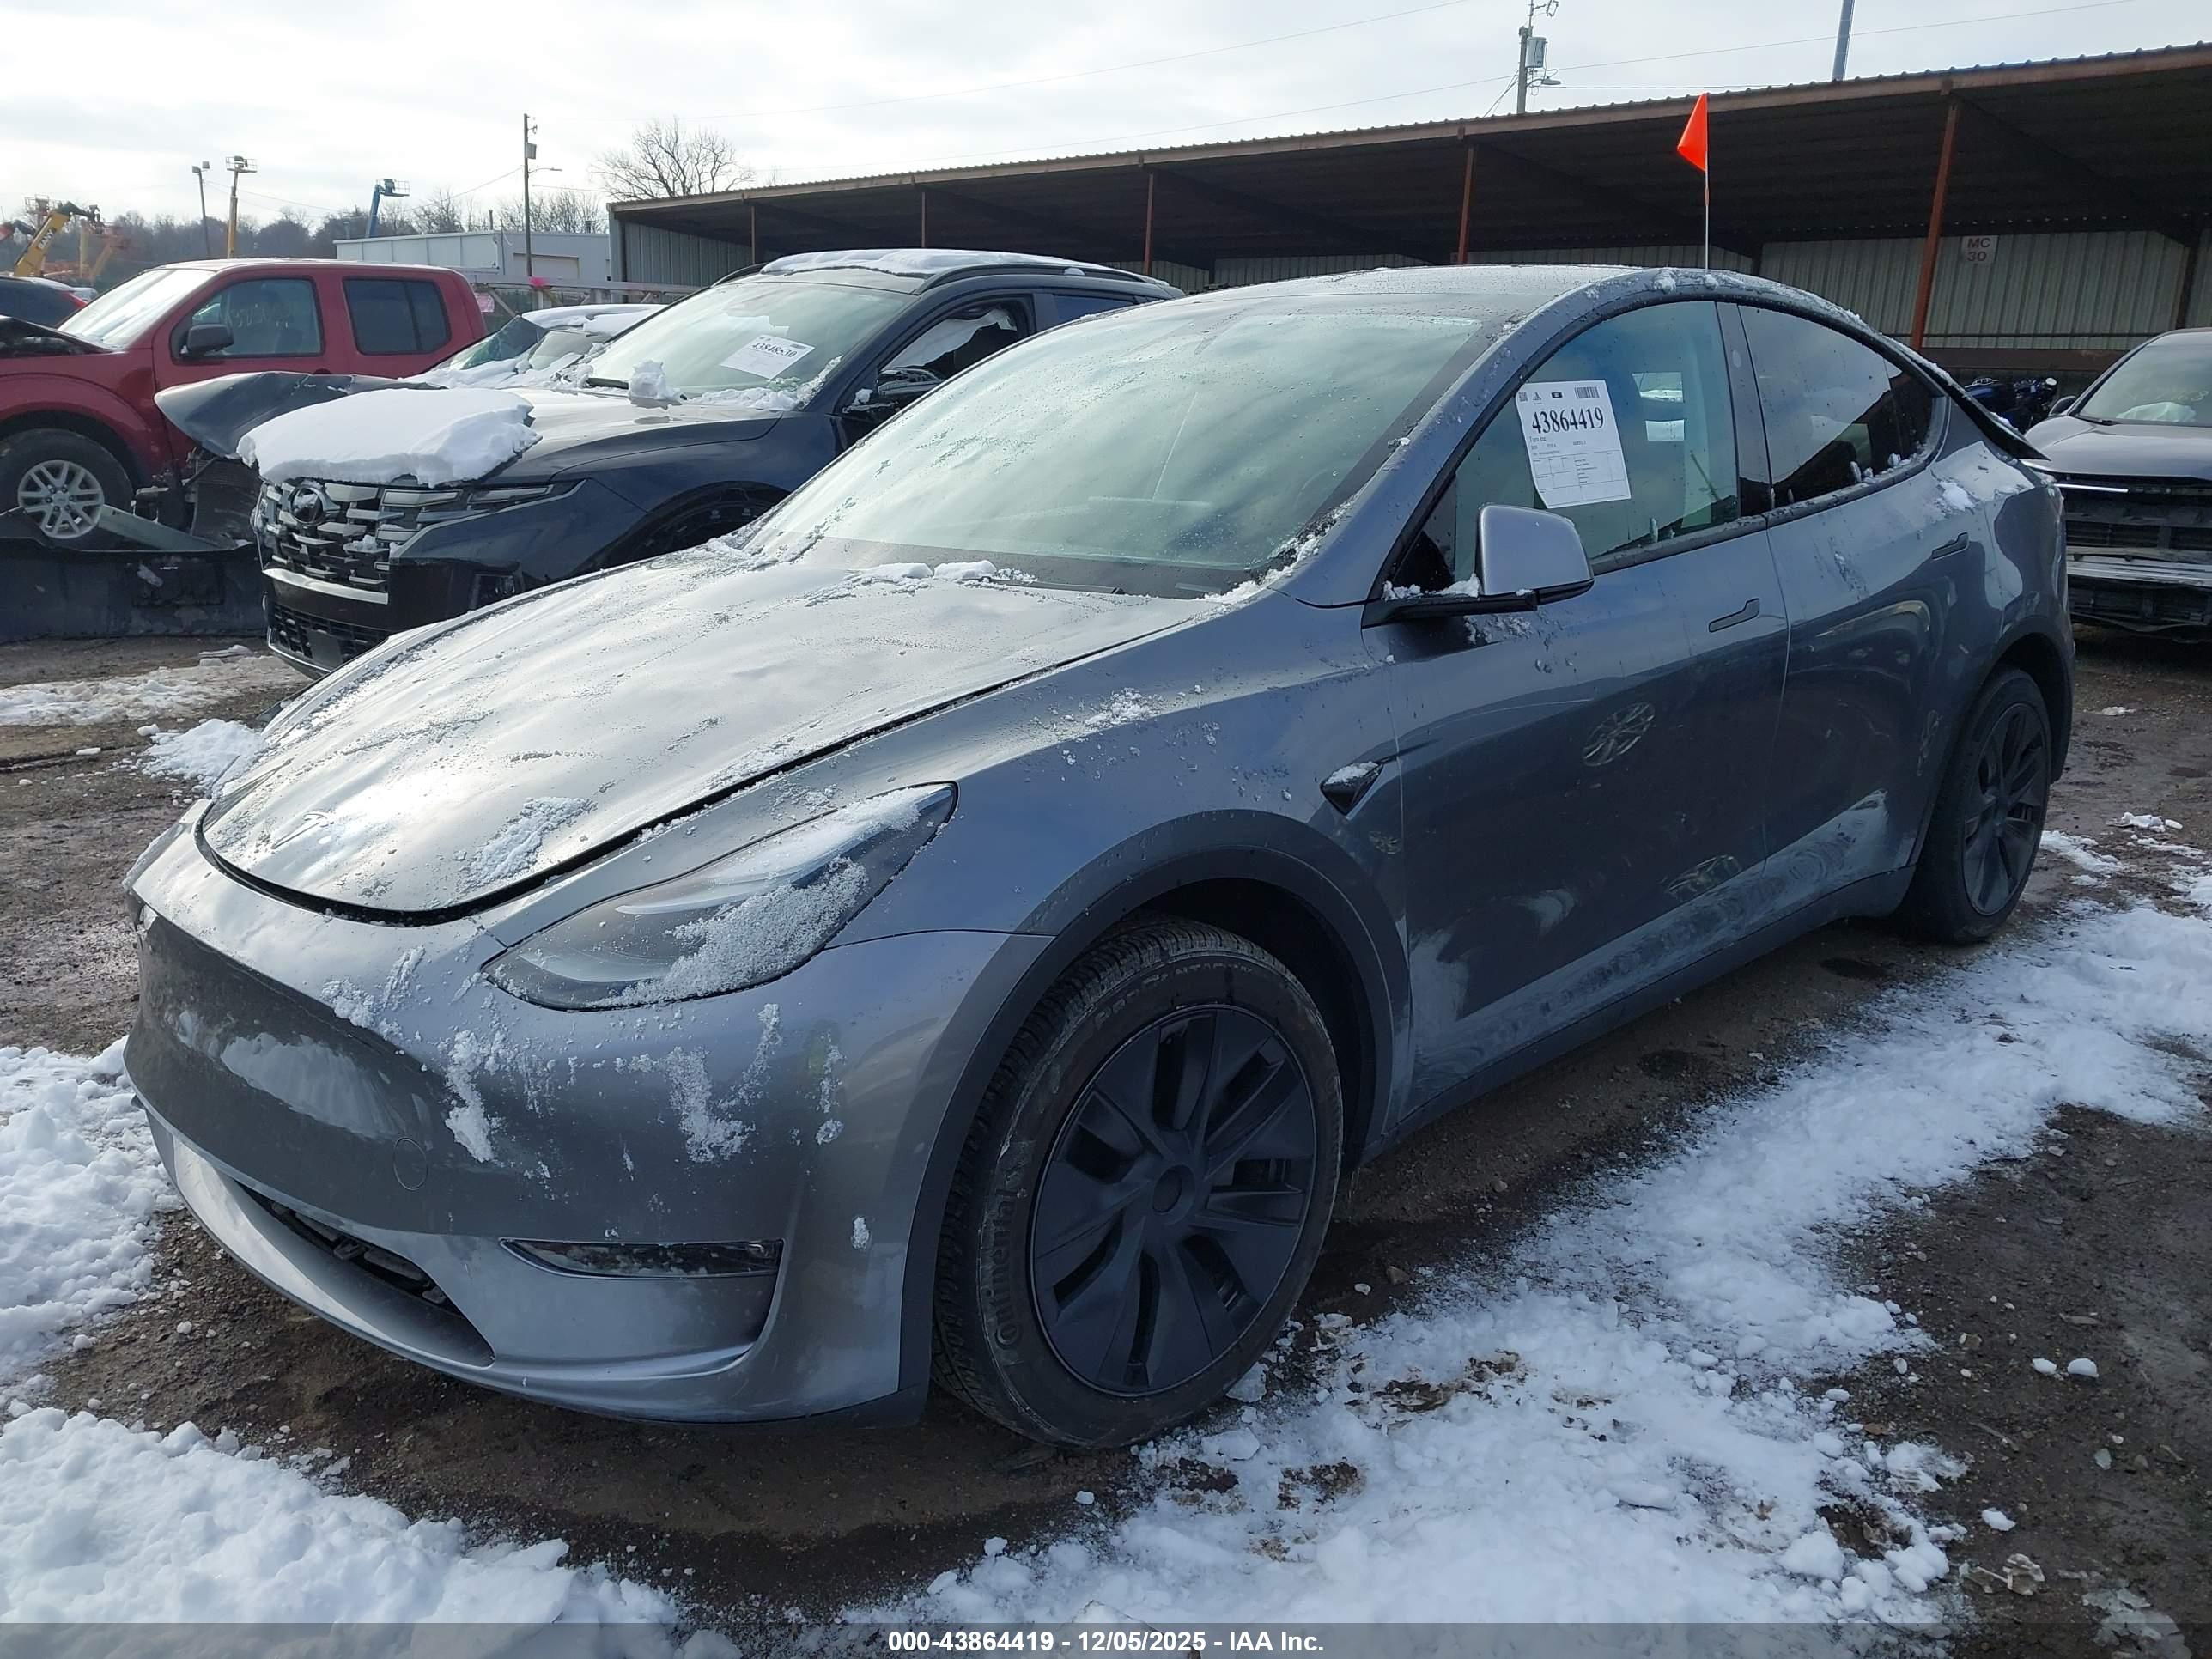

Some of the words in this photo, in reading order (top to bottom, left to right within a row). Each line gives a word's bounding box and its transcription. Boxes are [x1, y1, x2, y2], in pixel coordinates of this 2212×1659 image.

[1967, 237, 1990, 248] MC
[1967, 251, 1987, 262] 30
[1532, 406, 1604, 434] 43864419
